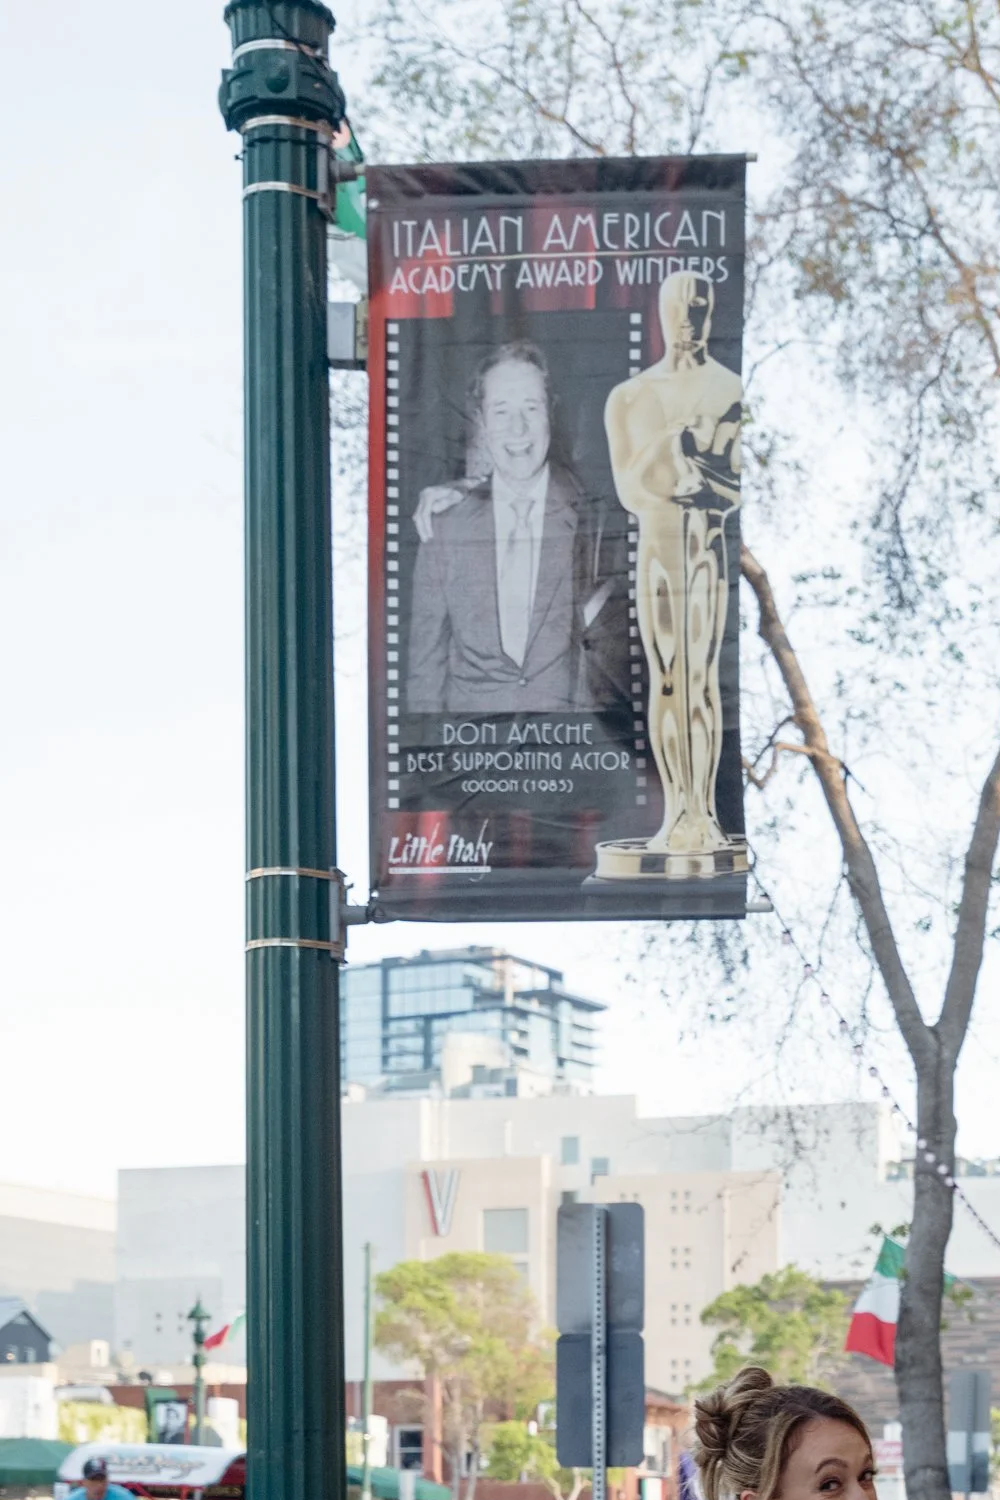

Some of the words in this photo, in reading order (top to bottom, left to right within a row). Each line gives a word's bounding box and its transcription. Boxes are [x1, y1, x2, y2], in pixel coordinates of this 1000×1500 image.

[393, 216, 523, 258] ITALIAN
[542, 210, 726, 251] AMERICAN
[389, 263, 506, 295] ACADEMY
[515, 259, 603, 289] AWARD
[443, 722, 497, 746] DON
[507, 722, 593, 746] AMECHE
[407, 752, 444, 773] BEST
[452, 751, 562, 772] SUPPORTING
[570, 751, 630, 771] ACTOR
[461, 779, 519, 793] COCOON
[522, 779, 575, 794] (1985)
[388, 821, 445, 865] Little
[446, 818, 494, 882] Italy
